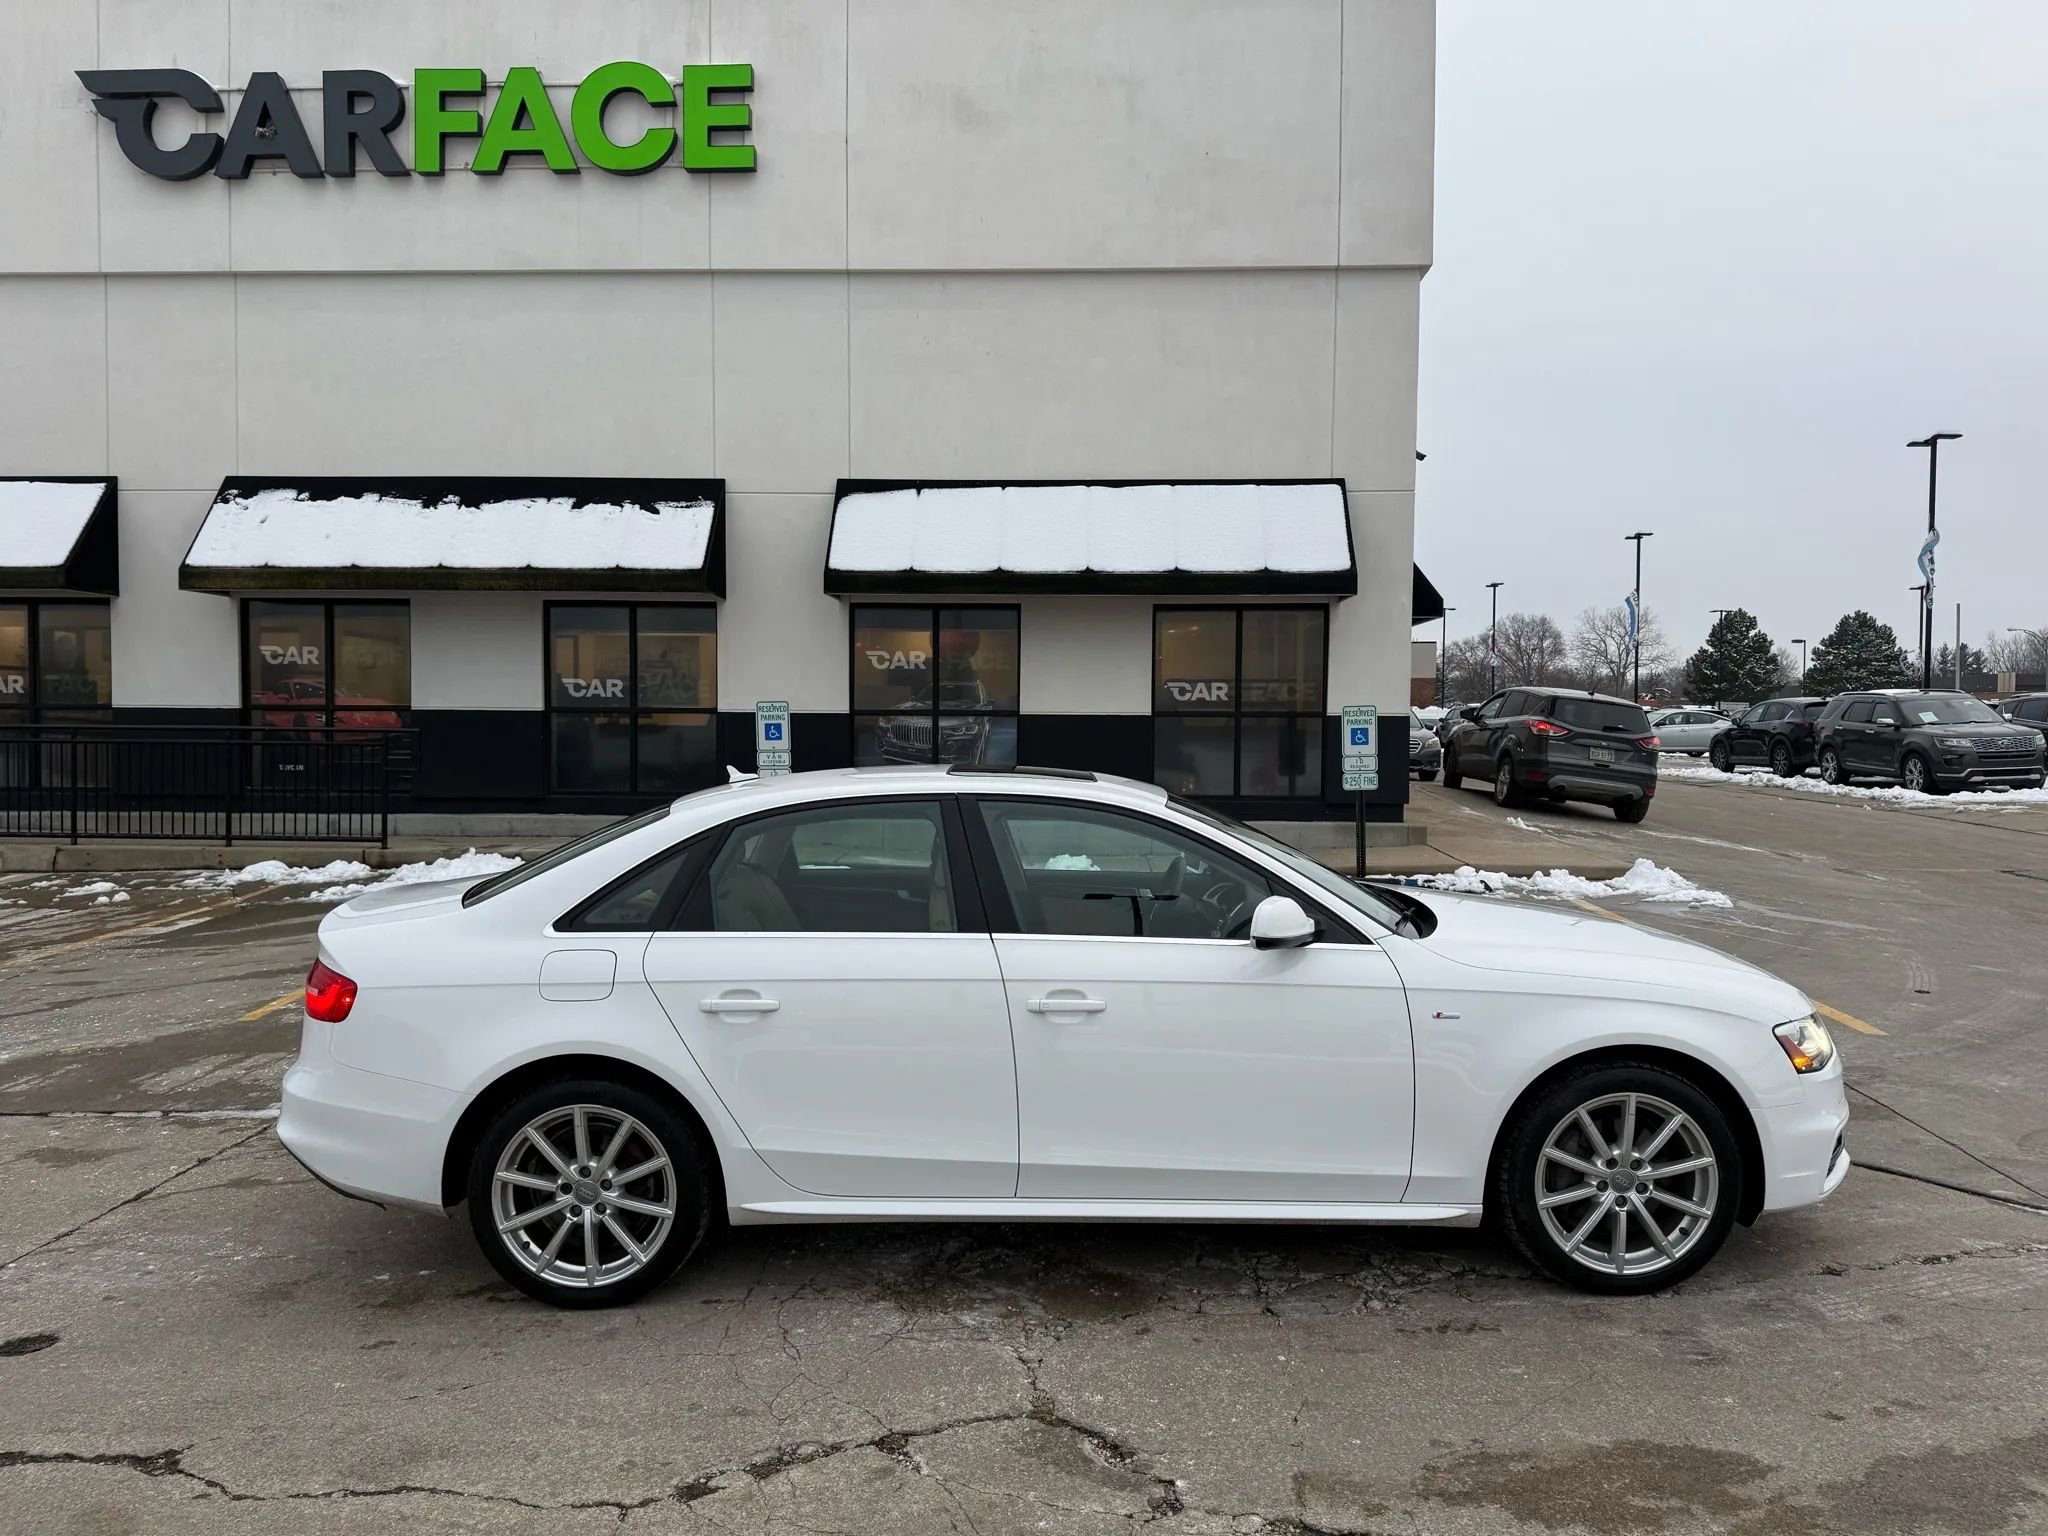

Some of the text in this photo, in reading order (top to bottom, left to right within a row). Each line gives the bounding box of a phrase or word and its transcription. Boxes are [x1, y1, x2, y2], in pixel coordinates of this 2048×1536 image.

[75, 61, 757, 181] CARFACE
[258, 645, 320, 665] CAR
[866, 650, 928, 671] CAR
[561, 678, 625, 698] CAR
[1166, 682, 1230, 702] CAR
[758, 705, 788, 713] RESERVED
[760, 713, 786, 721] PARKING
[1344, 709, 1375, 718] RESERVED
[1346, 718, 1373, 726] PARKING
[1344, 775, 1377, 787] $250 FINE
